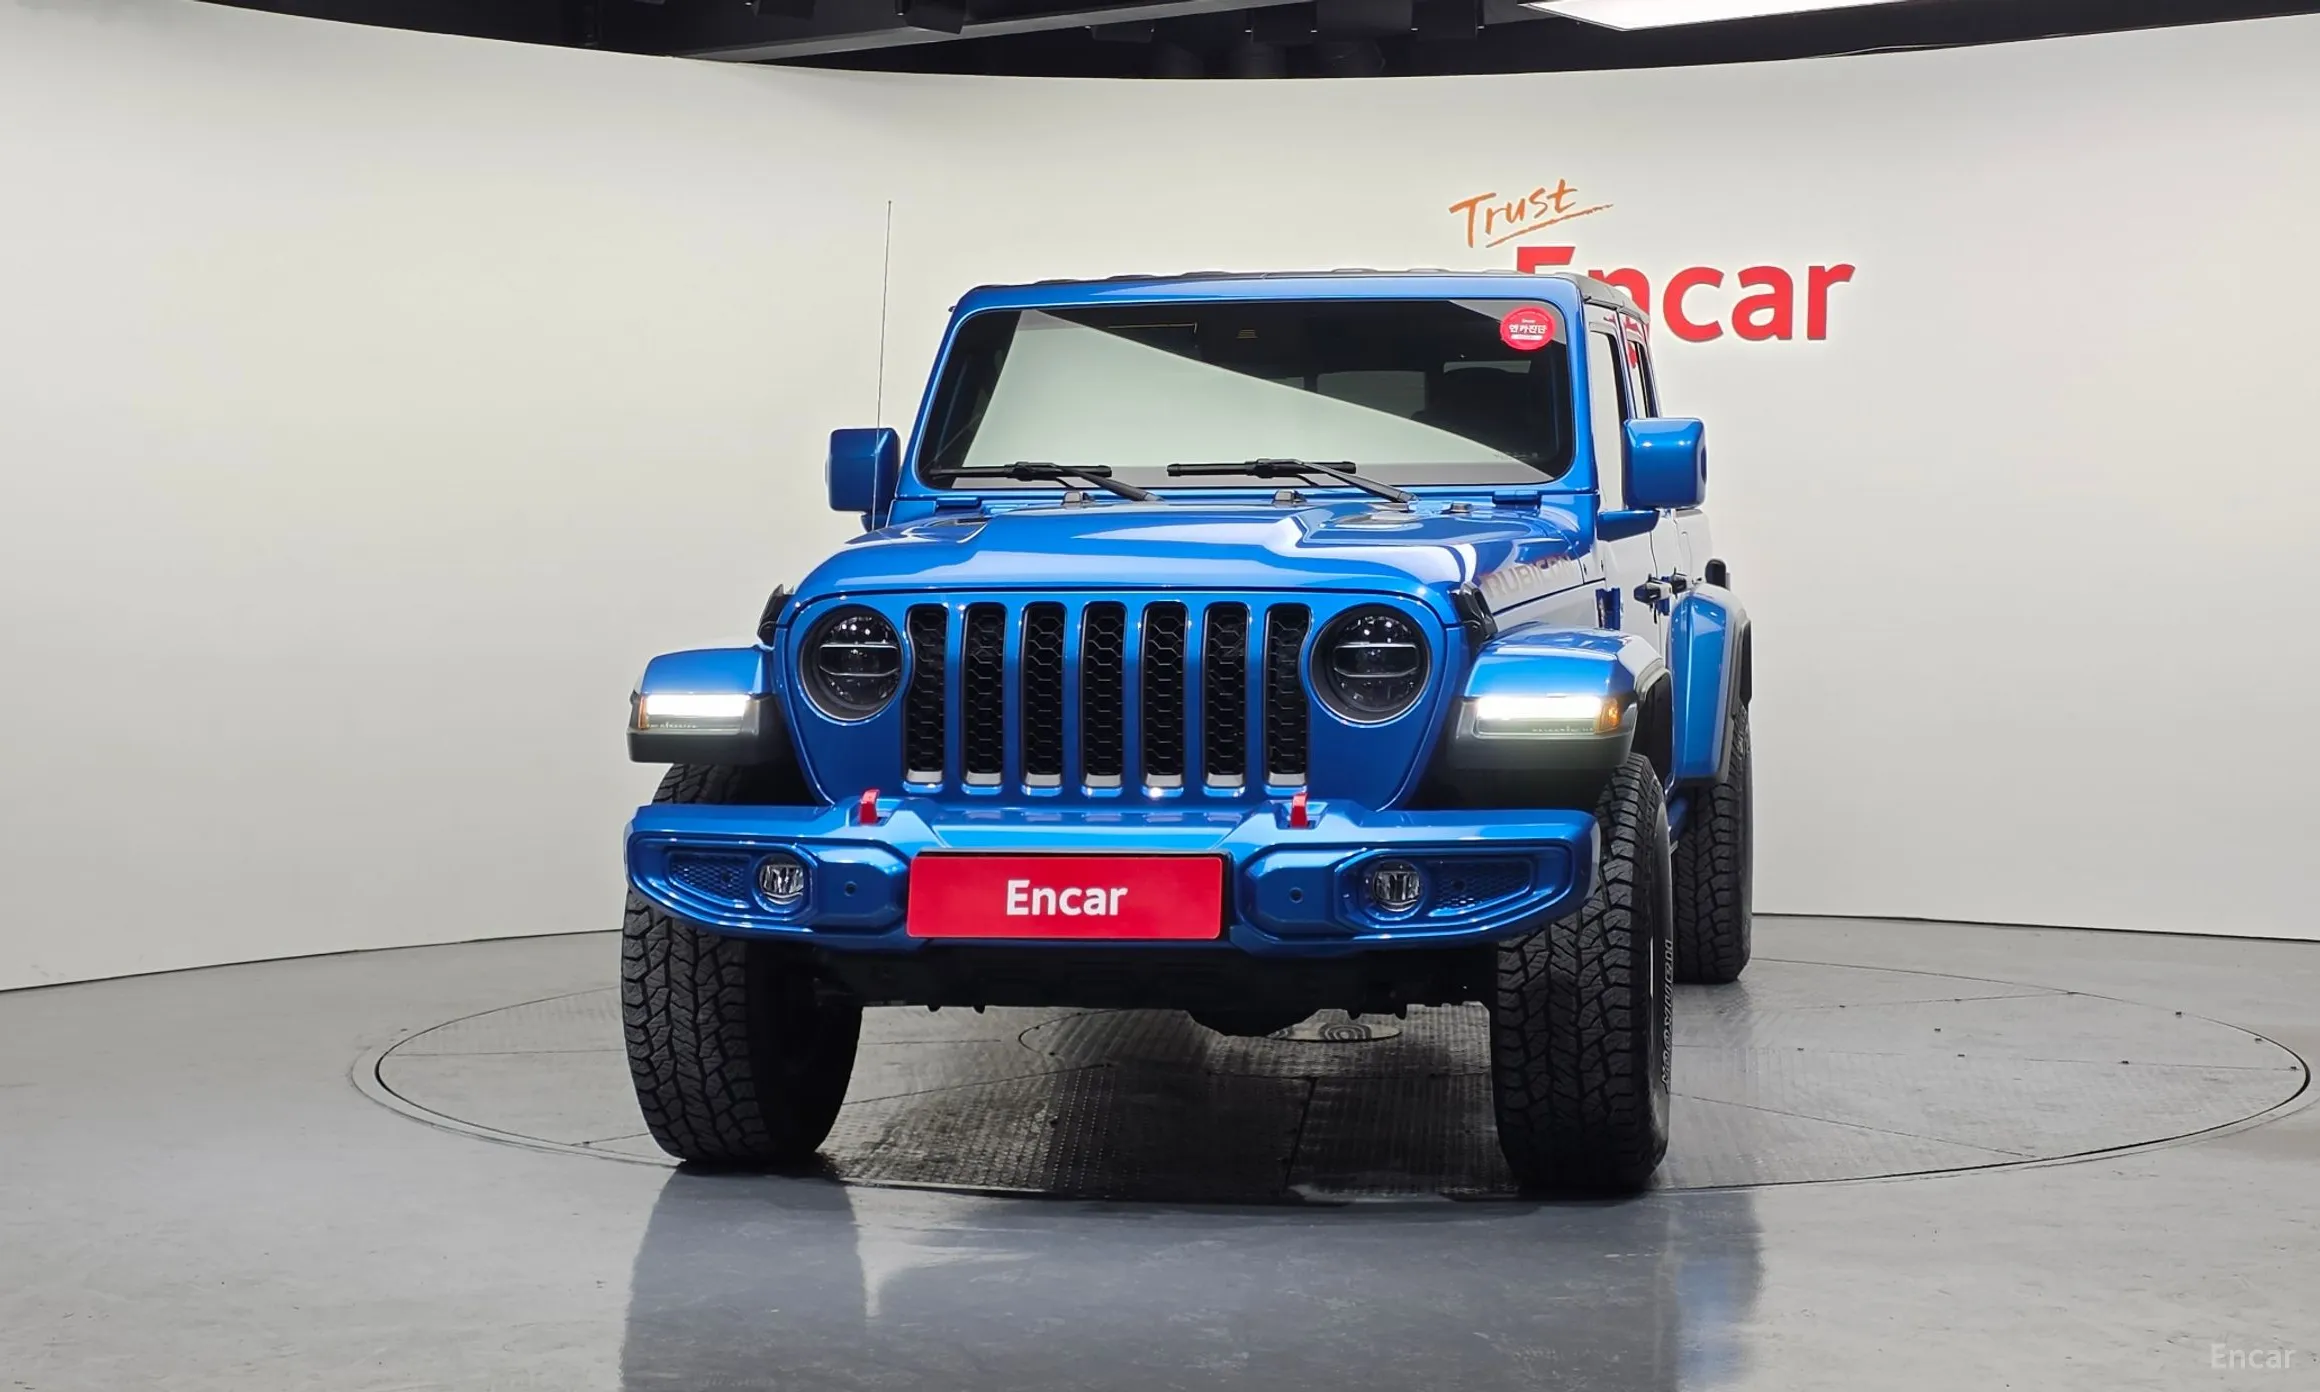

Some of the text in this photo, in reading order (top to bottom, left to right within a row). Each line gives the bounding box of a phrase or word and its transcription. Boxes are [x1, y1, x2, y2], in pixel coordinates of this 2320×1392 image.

[1449, 178, 1578, 248] Trust
[1516, 246, 1856, 342] car
[1481, 554, 1573, 598] RUBICON
[1006, 879, 1128, 916] Encar
